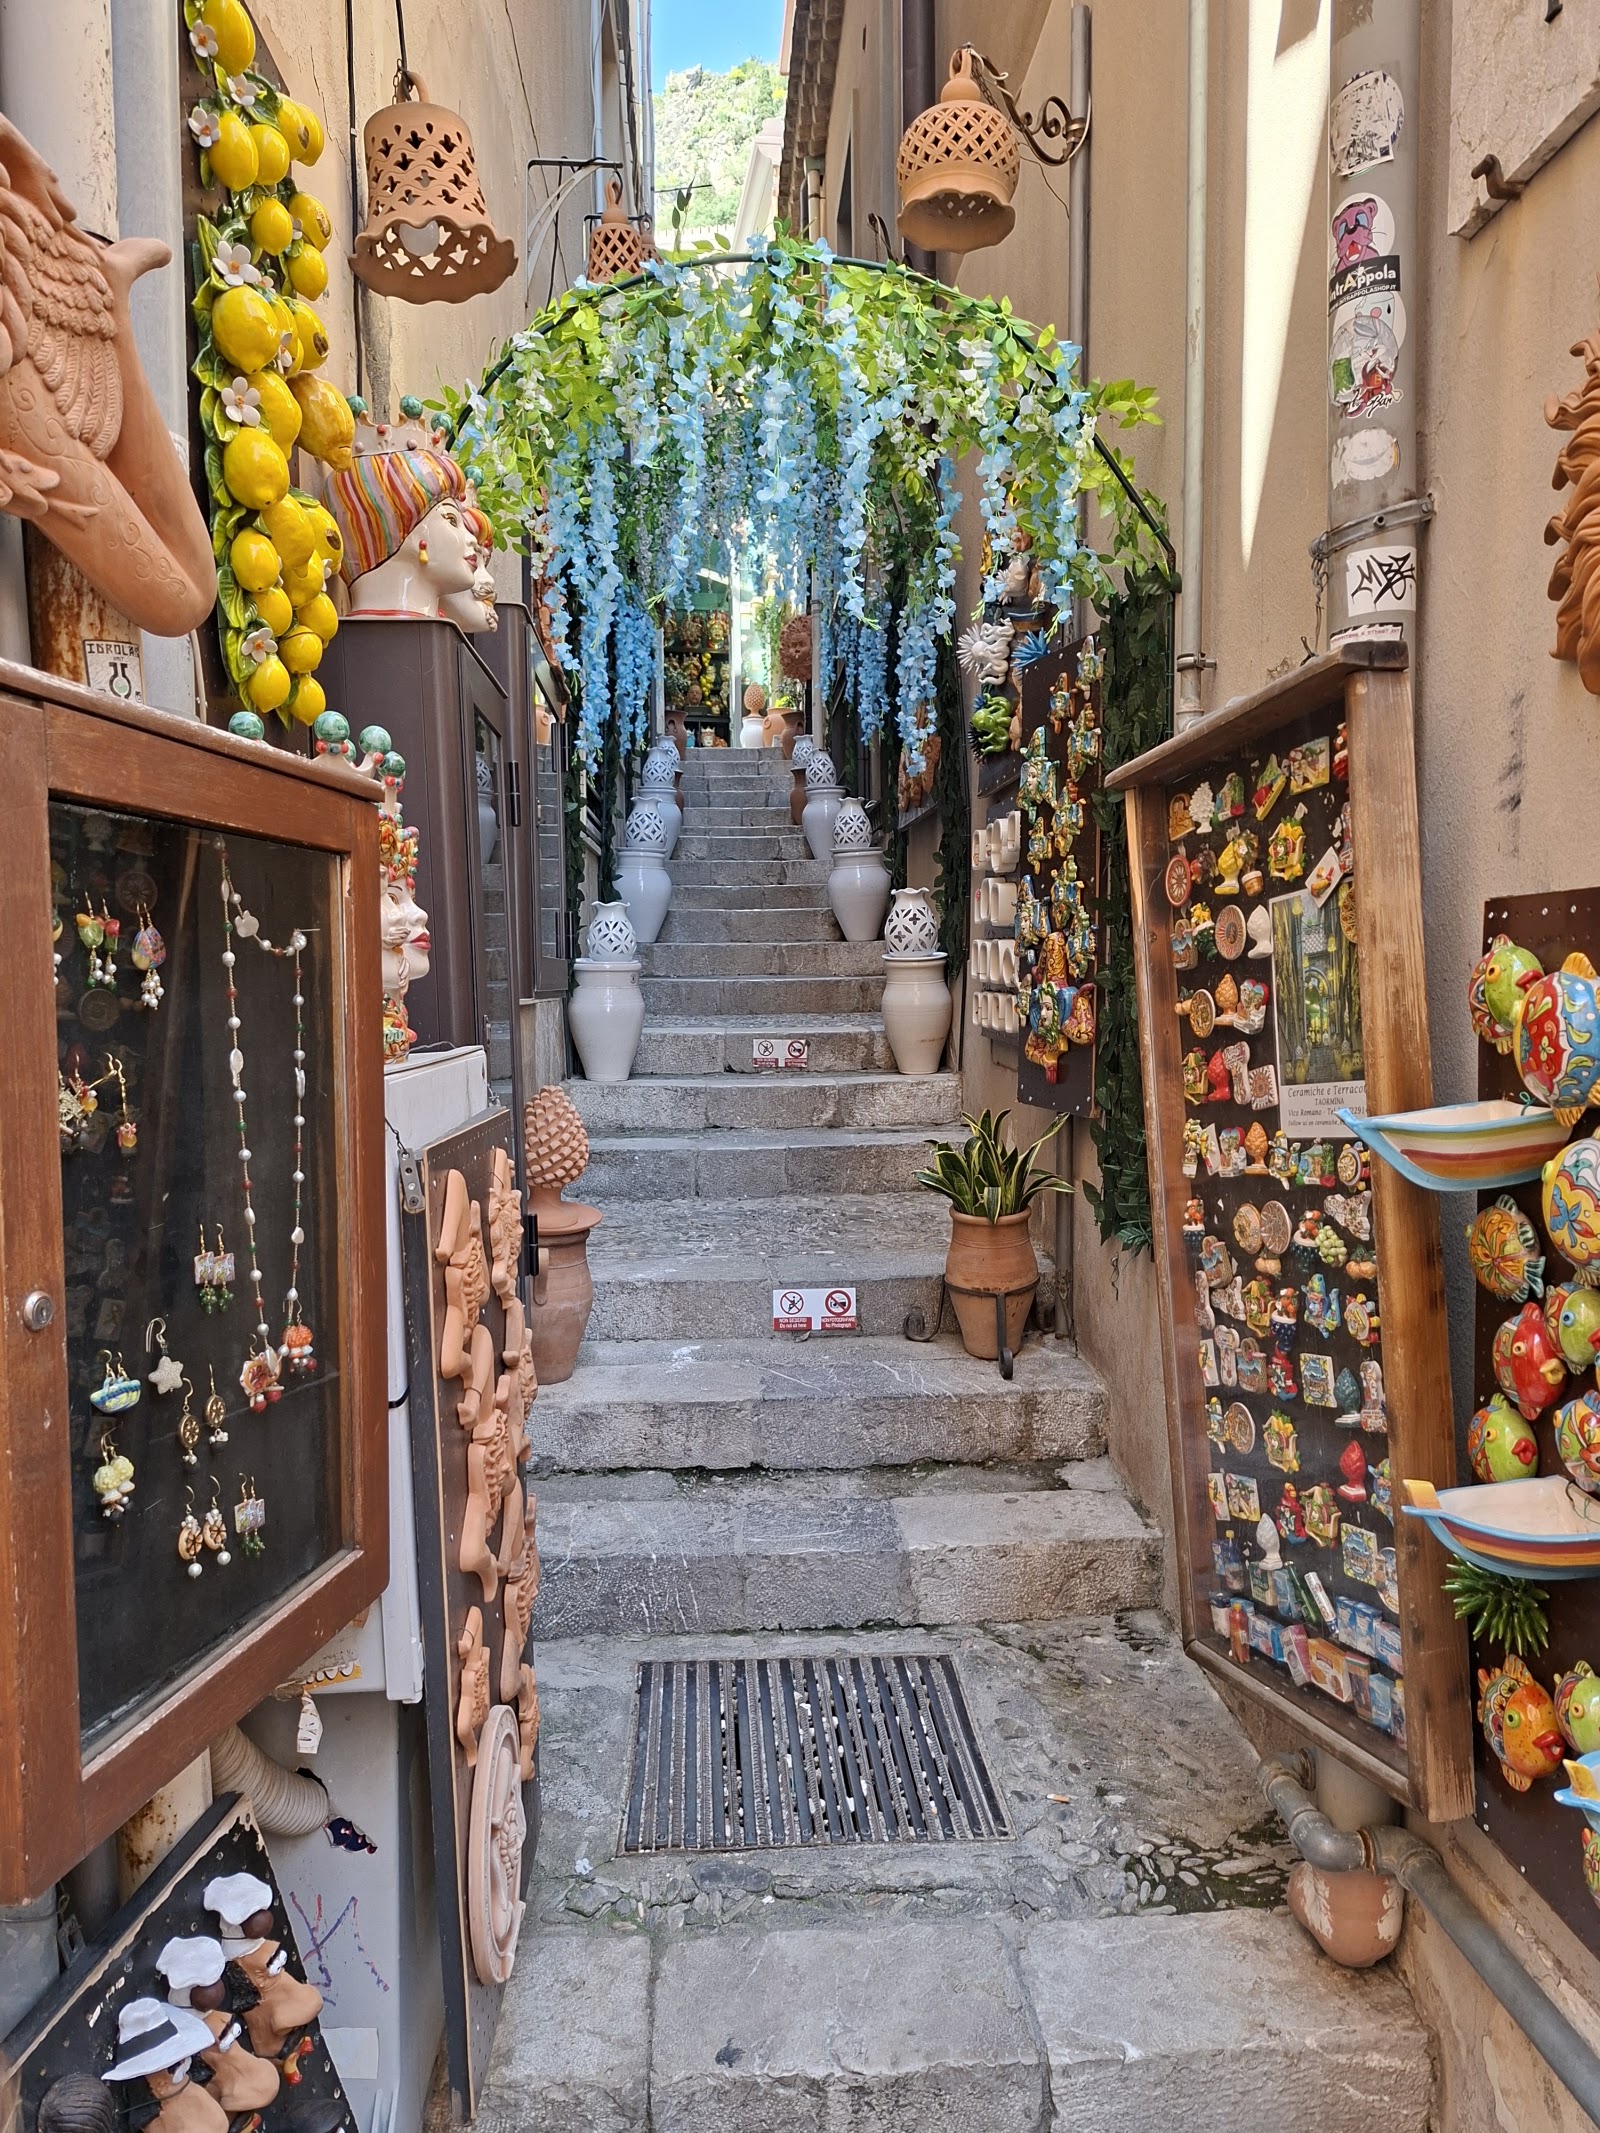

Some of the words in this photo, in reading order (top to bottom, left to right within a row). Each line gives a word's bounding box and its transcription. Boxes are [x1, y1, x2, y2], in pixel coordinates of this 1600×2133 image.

[1288, 1086, 1324, 1097] Ceramiche
[1314, 1098, 1344, 1106] TAORMINA
[1300, 1108, 1322, 1116] Romano
